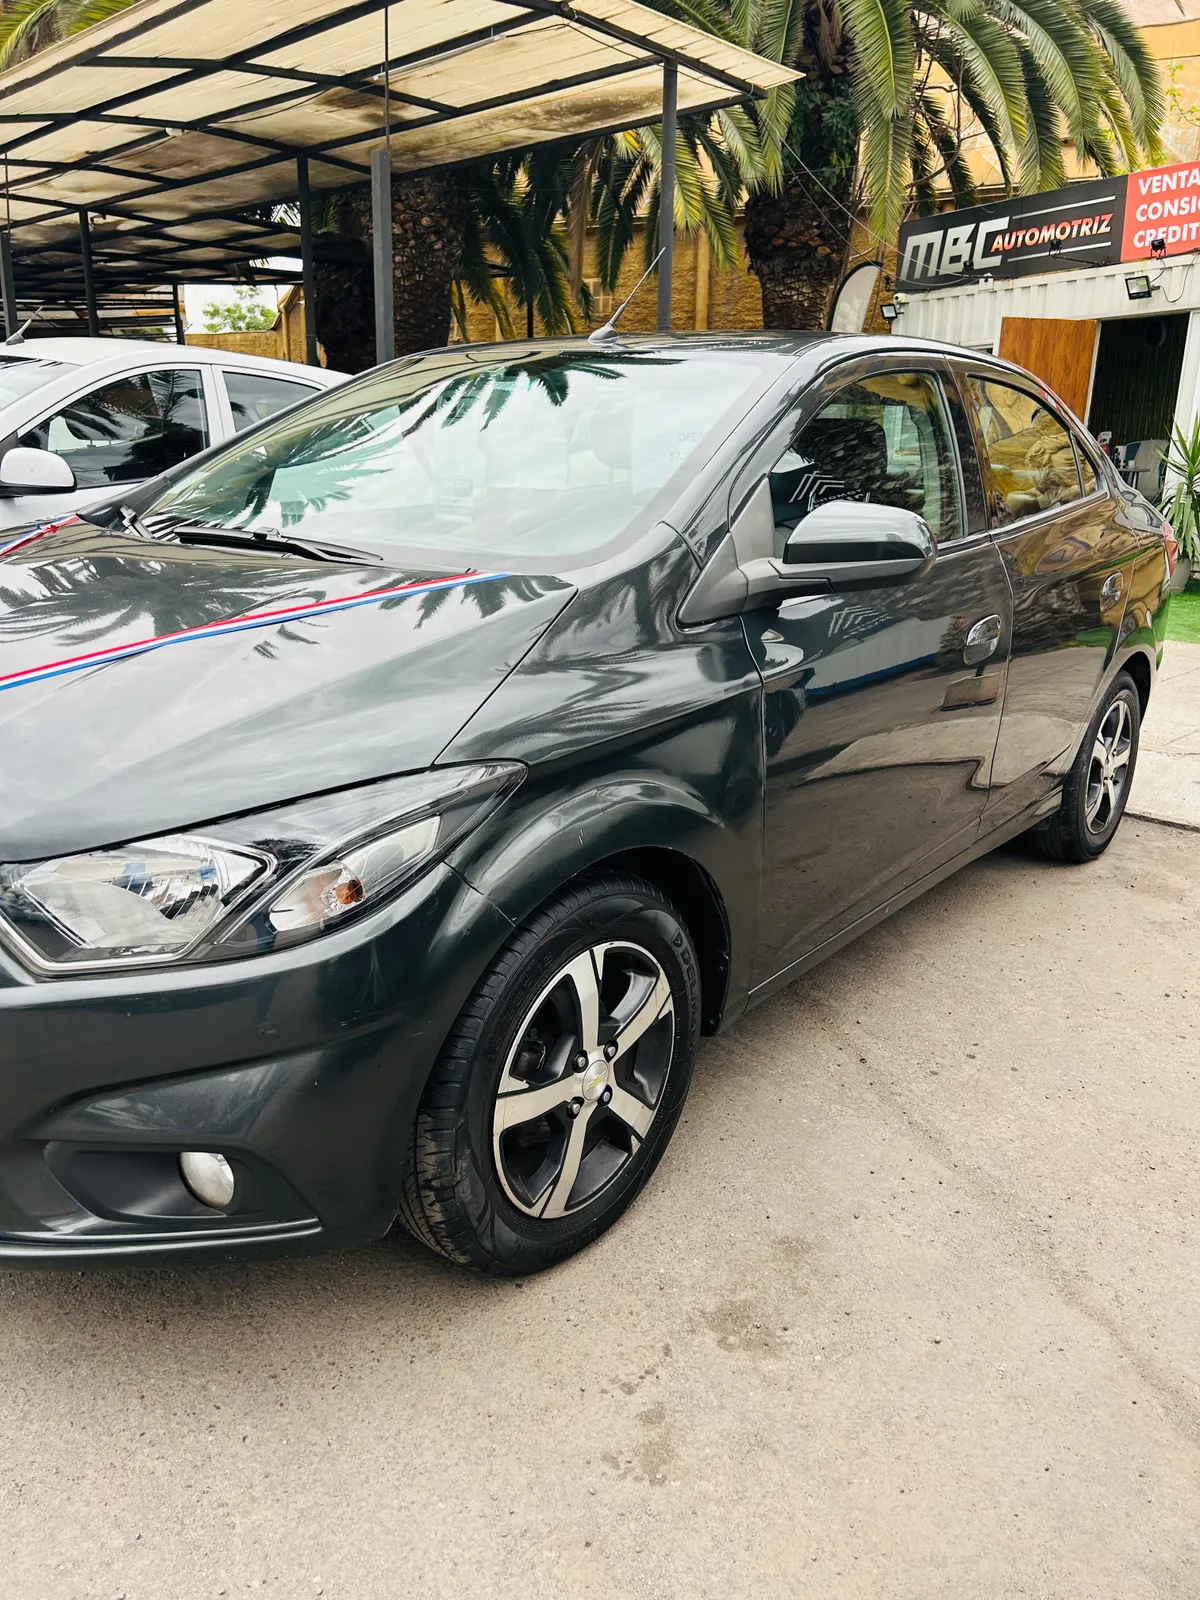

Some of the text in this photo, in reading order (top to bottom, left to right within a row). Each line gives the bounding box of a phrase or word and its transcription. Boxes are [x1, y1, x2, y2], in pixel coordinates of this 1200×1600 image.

[1138, 168, 1200, 196] VENTA
[1136, 195, 1200, 222] CONSI
[901, 213, 1113, 281] MBC AUTOMOTRIZ
[1133, 221, 1200, 248] CREDIT
